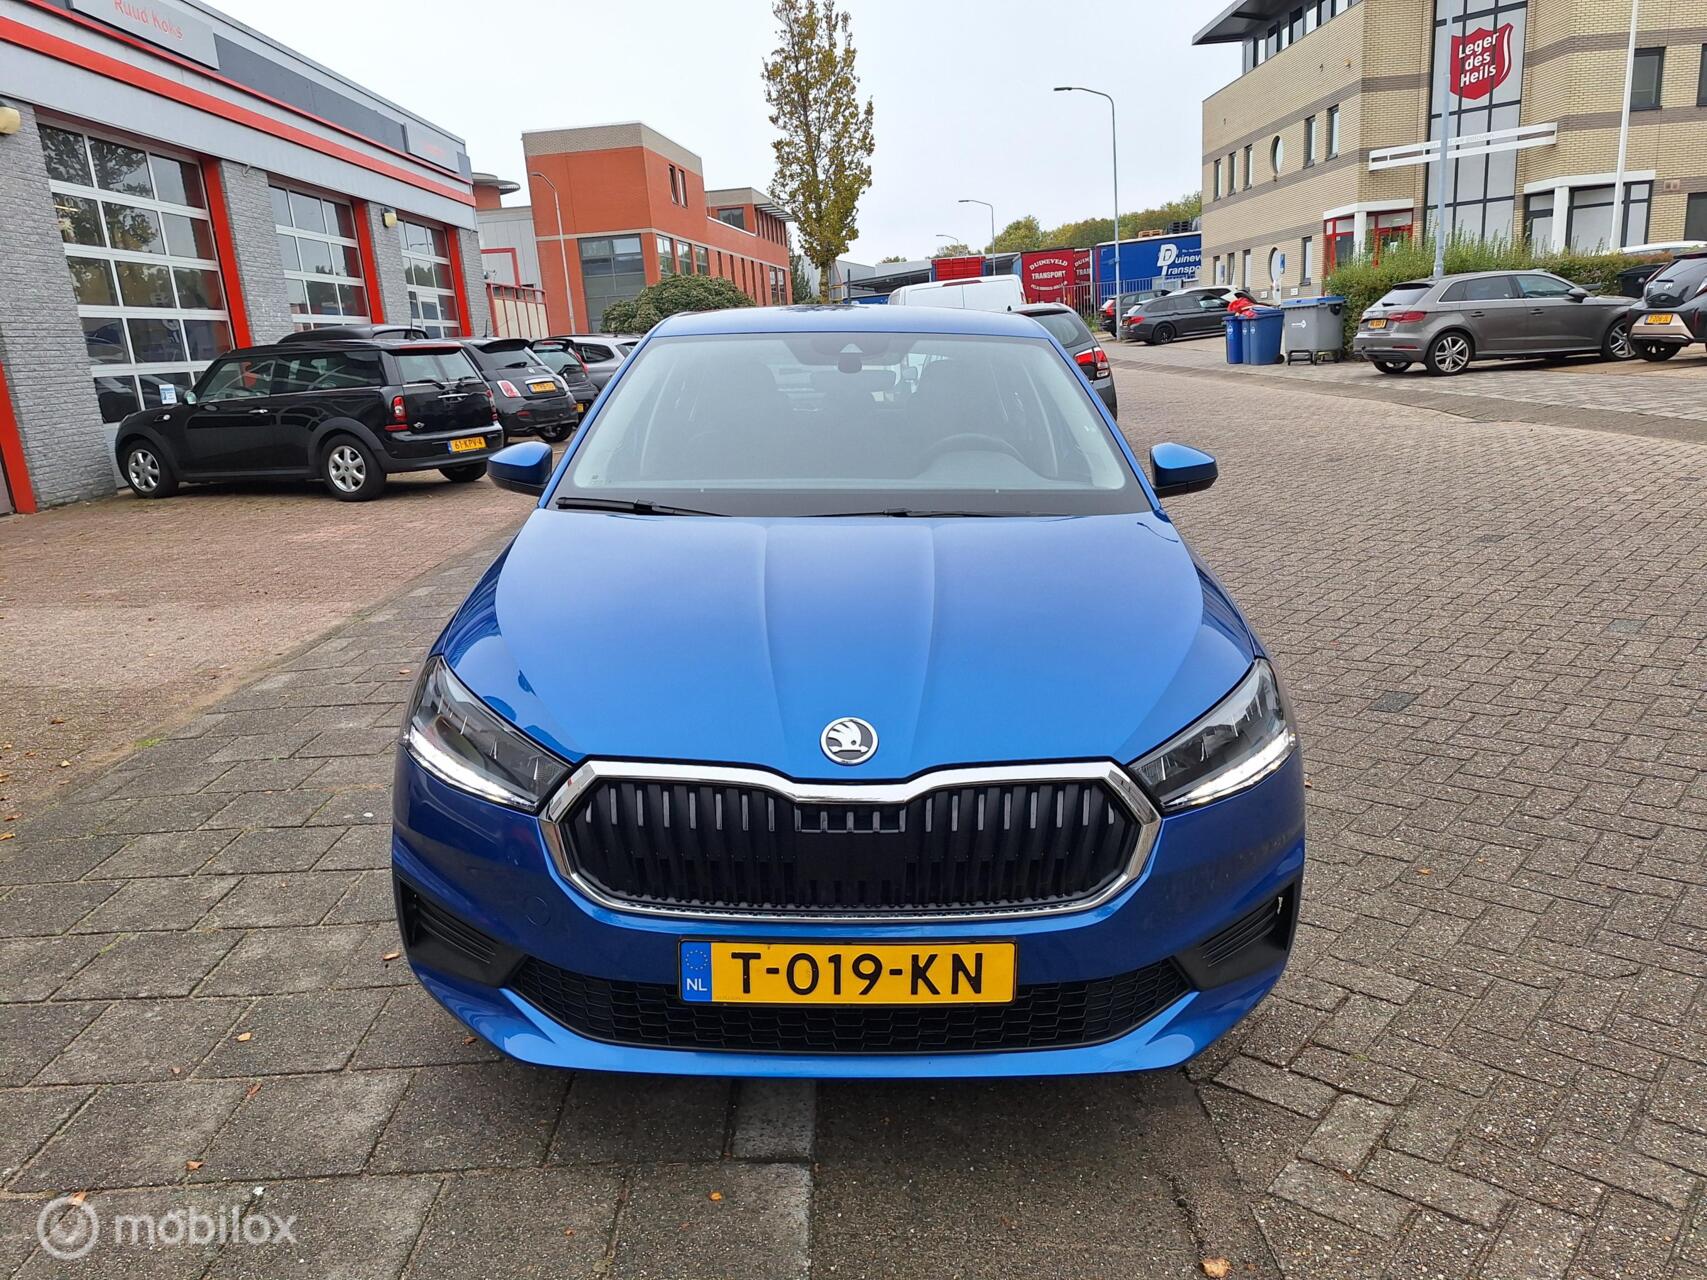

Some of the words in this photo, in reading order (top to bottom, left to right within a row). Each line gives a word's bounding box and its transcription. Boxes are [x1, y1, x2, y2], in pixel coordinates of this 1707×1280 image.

[114, 0, 149, 24] Ruud
[1459, 33, 1499, 58] Leger
[1465, 52, 1491, 70] des
[1461, 65, 1496, 87] Heils
[1029, 258, 1068, 271] DUINEVELD
[1032, 270, 1066, 280] TRANSPORT
[686, 978, 707, 991] NL
[731, 952, 983, 995] T-019-KN
